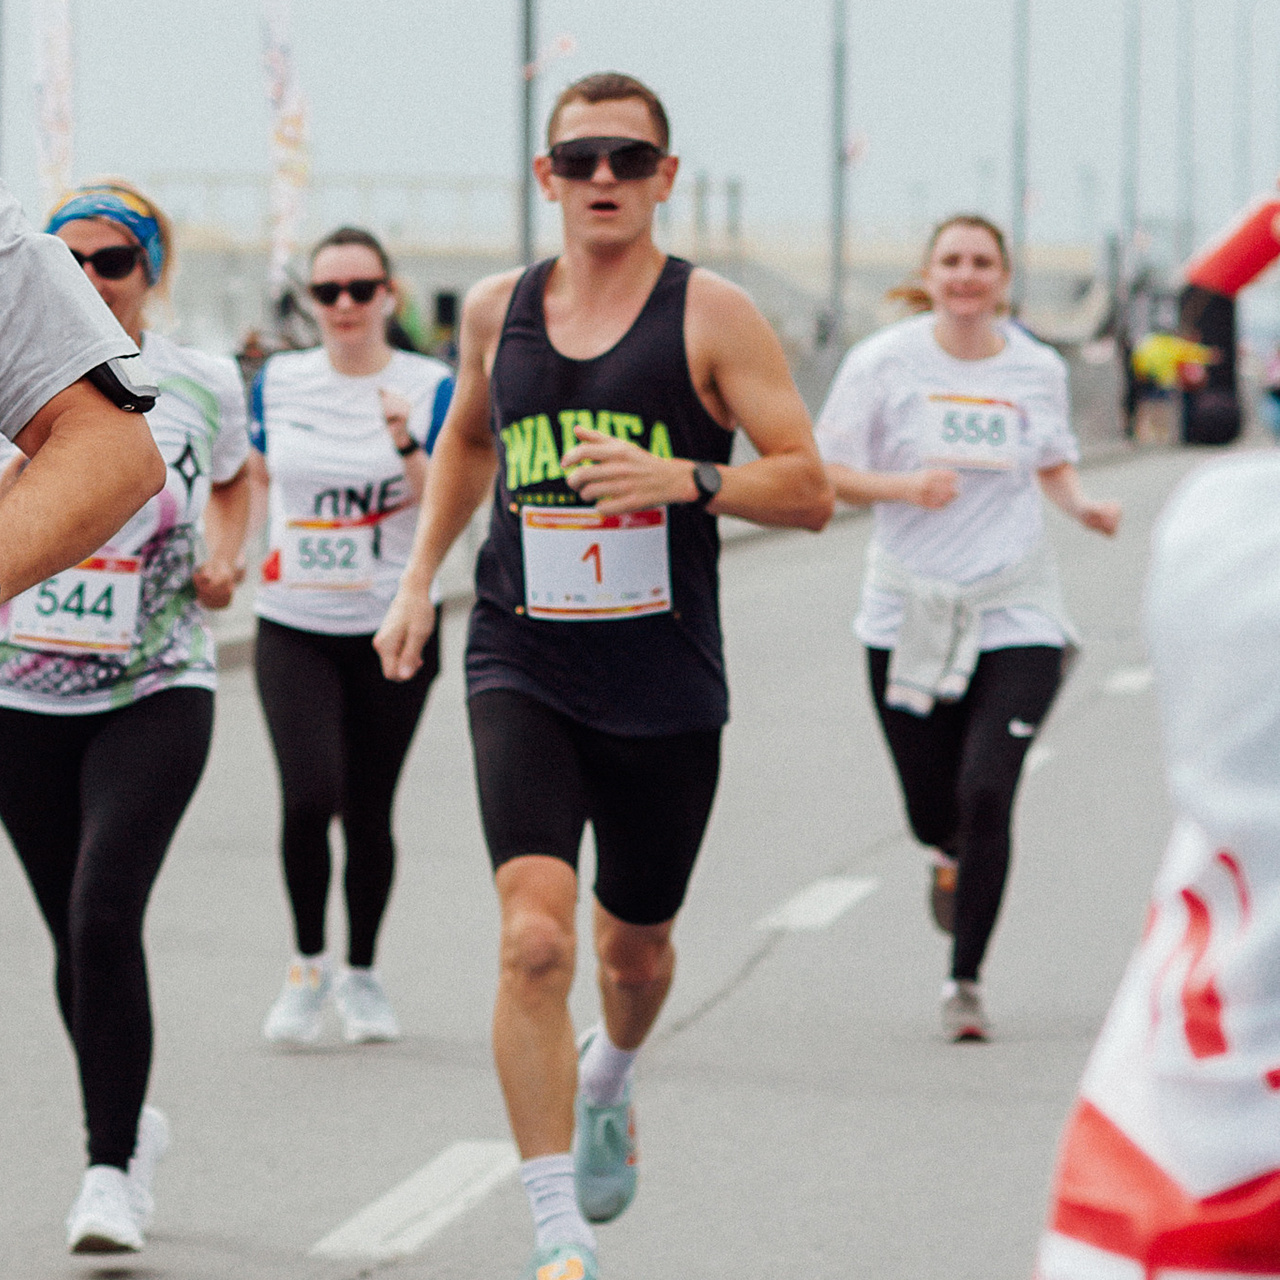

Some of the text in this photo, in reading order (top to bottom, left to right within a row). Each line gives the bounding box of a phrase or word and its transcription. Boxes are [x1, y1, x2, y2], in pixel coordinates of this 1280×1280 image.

[941, 410, 1007, 447] 558
[298, 537, 359, 570] 552
[581, 542, 603, 584] 1
[35, 578, 115, 622] 544
